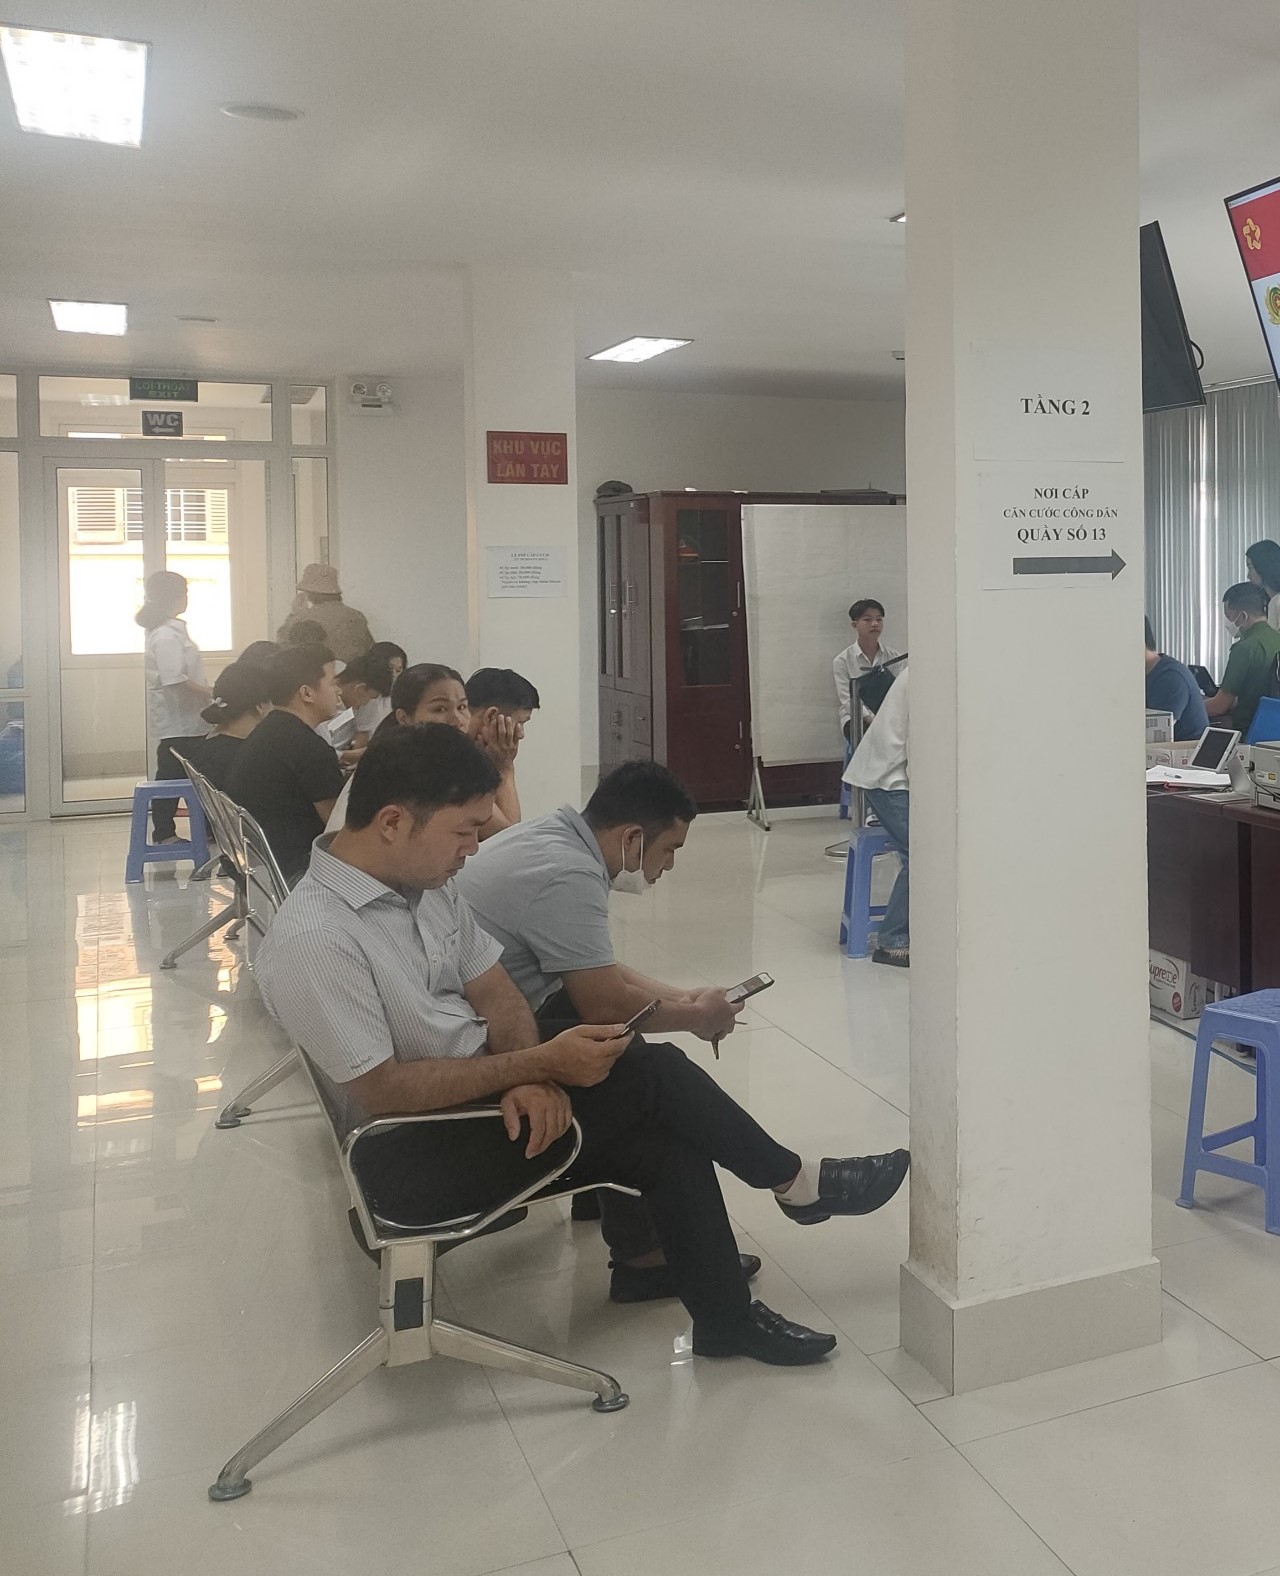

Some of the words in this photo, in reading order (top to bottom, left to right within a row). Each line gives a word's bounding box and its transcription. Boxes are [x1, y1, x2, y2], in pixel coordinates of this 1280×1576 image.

[1020, 393, 1076, 415] TẦNG
[1081, 400, 1090, 415] 2
[146, 413, 179, 426] WC
[492, 440, 525, 455] KHU
[529, 439, 561, 458] VỰC
[530, 463, 560, 478] TAY
[1034, 487, 1058, 499] NƠI
[1062, 485, 1089, 499] CẤP
[1003, 507, 1026, 518] CĂN
[1029, 506, 1060, 518] CƯỚC
[1063, 507, 1094, 518] CÔNG
[1096, 507, 1118, 518] DÂN
[1017, 524, 1063, 544] QUẦY
[1067, 525, 1087, 541] SỐ
[1092, 528, 1106, 541] 13
[1149, 961, 1177, 984] upreme
